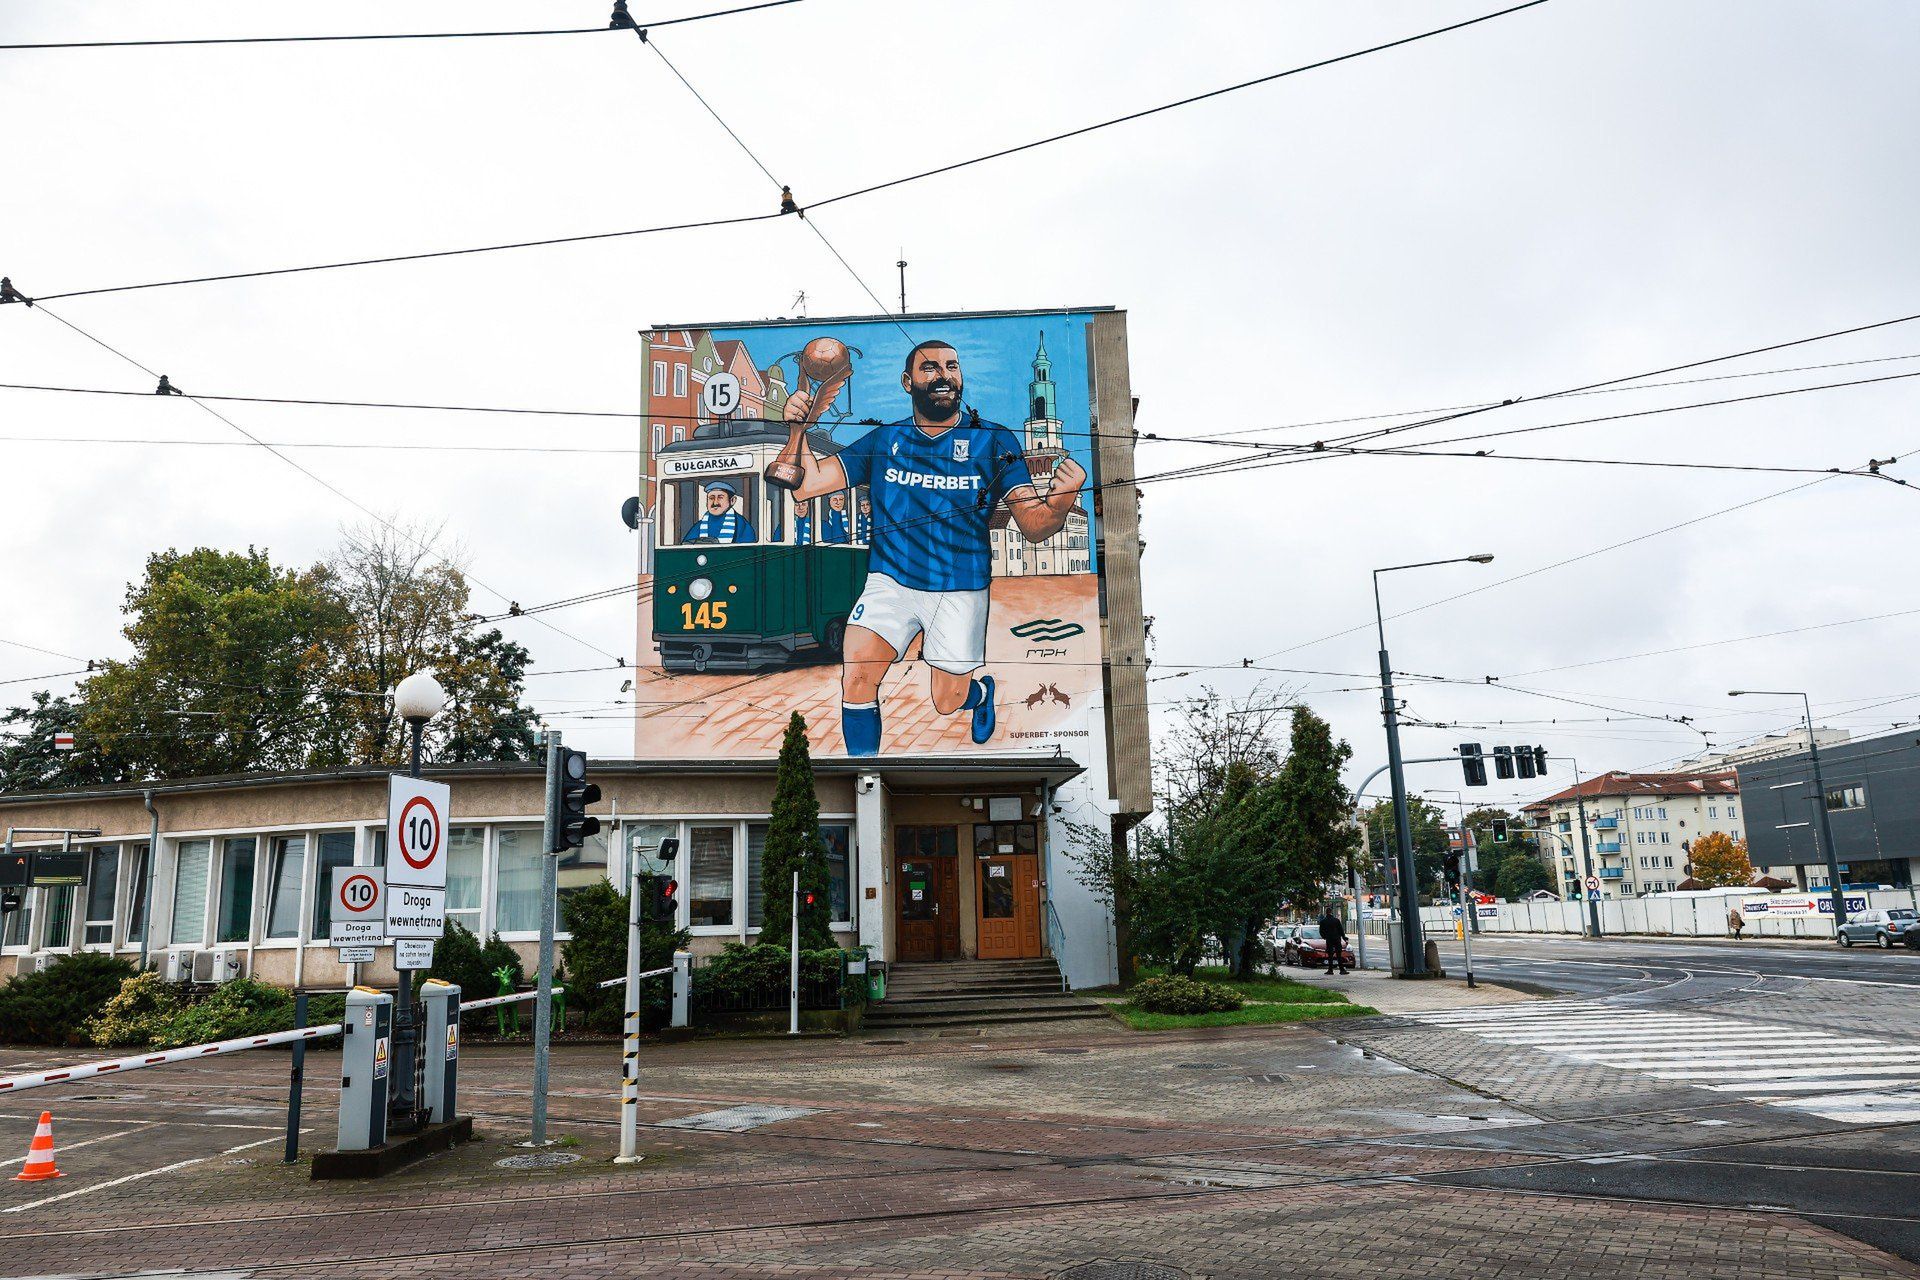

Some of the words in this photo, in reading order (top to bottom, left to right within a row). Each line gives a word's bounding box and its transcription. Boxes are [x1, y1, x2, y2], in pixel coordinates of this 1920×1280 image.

[711, 384, 730, 407] 15
[675, 458, 738, 471] BUŁGARSKA
[884, 468, 981, 489] SUPERBET
[681, 601, 728, 630] 145
[853, 603, 865, 621] 9
[1026, 649, 1067, 658] MPK
[1053, 730, 1089, 738] SPONSOR
[409, 817, 432, 850] 10
[350, 885, 371, 902] 10
[403, 892, 431, 910] Droga
[1853, 900, 1865, 910] GK
[345, 924, 371, 932] Droga
[389, 914, 442, 929] wewnętrzna
[333, 933, 382, 942] wewnętrzna
